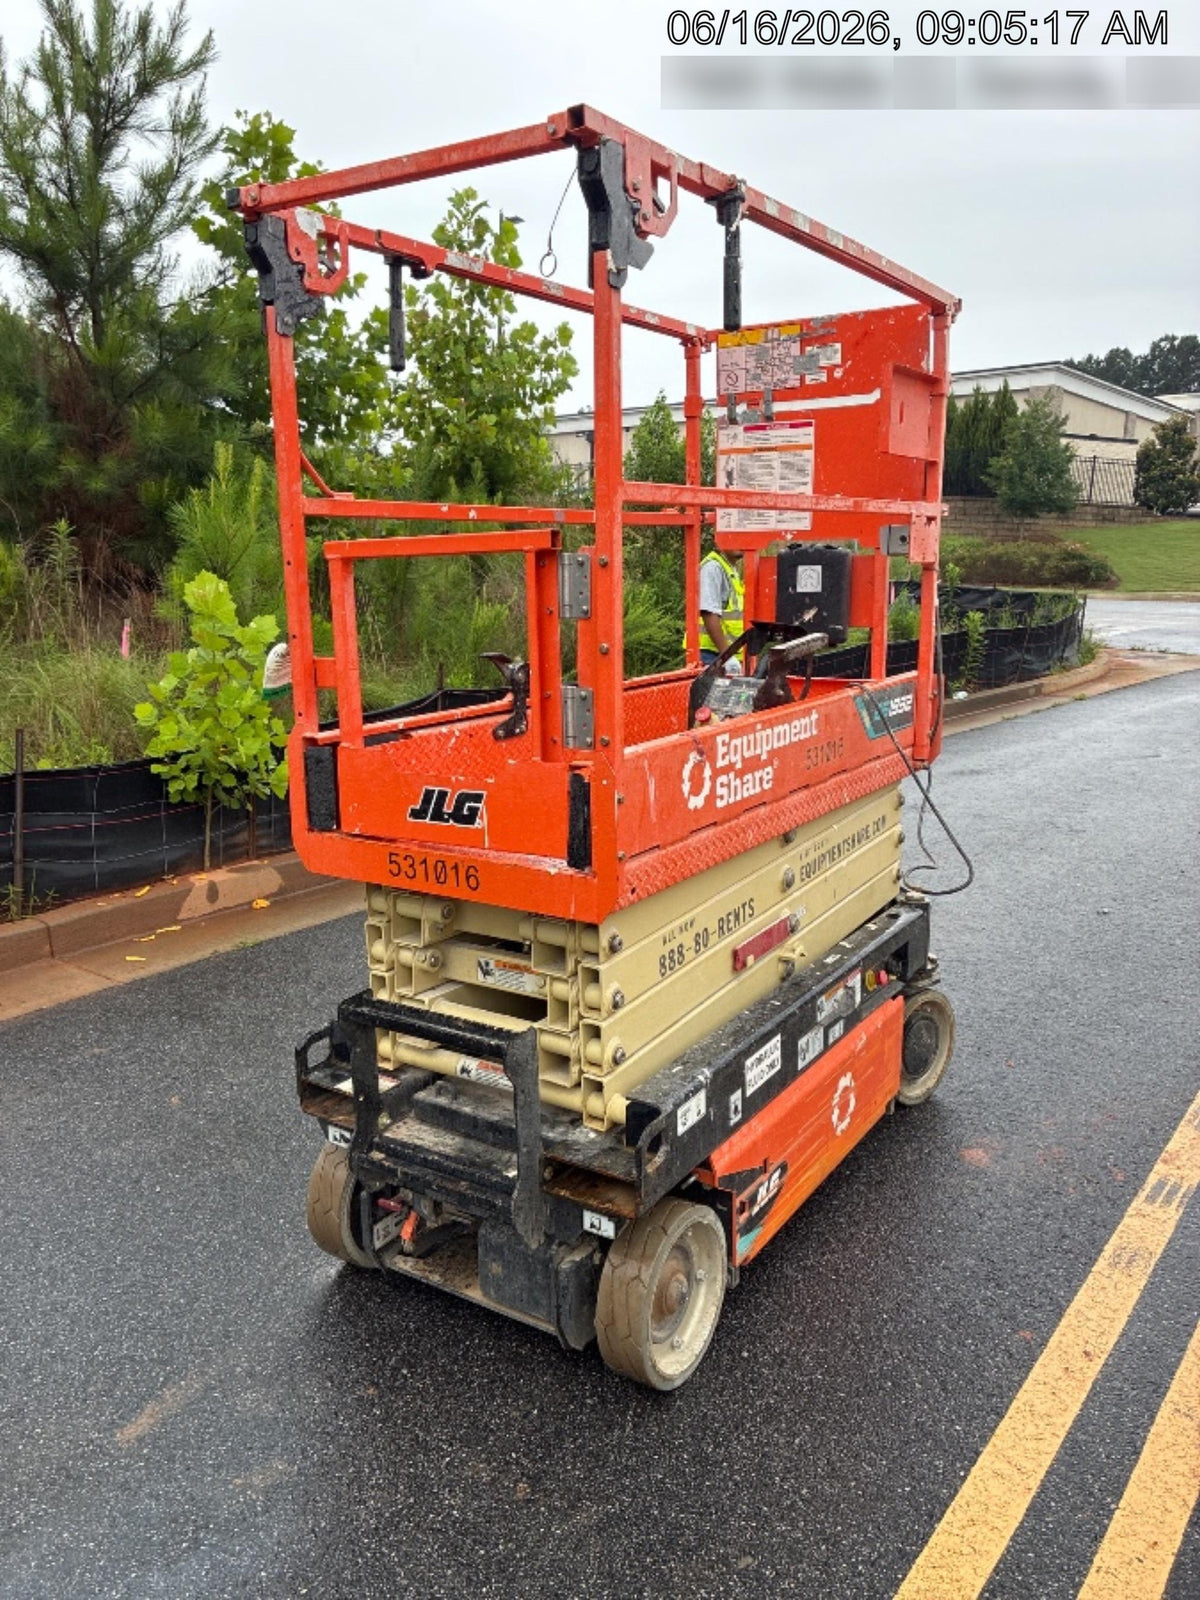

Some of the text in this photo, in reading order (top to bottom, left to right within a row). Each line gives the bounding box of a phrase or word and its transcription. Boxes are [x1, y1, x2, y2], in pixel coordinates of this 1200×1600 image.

[715, 709, 819, 769] Equipment
[406, 785, 487, 828] JLG
[715, 765, 774, 809] Share
[388, 852, 481, 892] 531016
[659, 897, 755, 978] 888-80-RENTS
